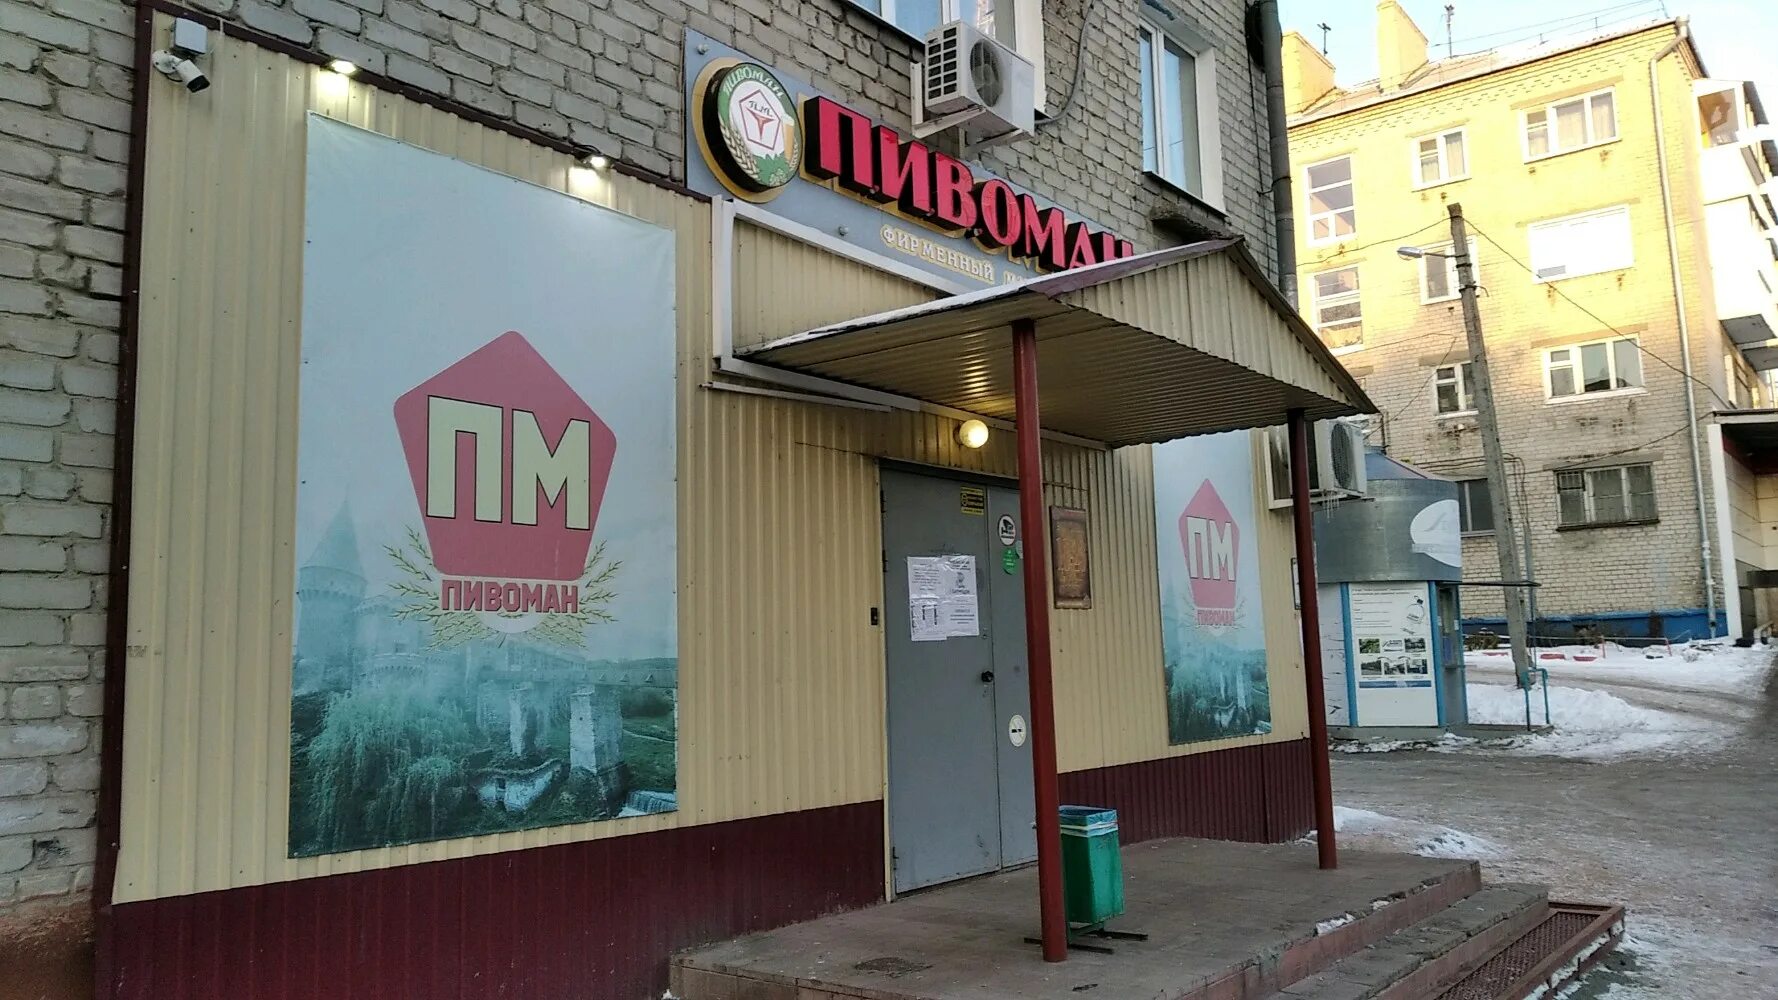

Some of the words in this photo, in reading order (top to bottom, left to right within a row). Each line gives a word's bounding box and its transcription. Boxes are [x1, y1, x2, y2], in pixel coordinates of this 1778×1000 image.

[723, 66, 784, 98] ПИВОМАН
[882, 226, 995, 282] ФИРМЕННЫЙ
[426, 394, 591, 531] ПМ
[1186, 515, 1236, 582] ПМ
[441, 579, 578, 613] ПИВОМАН
